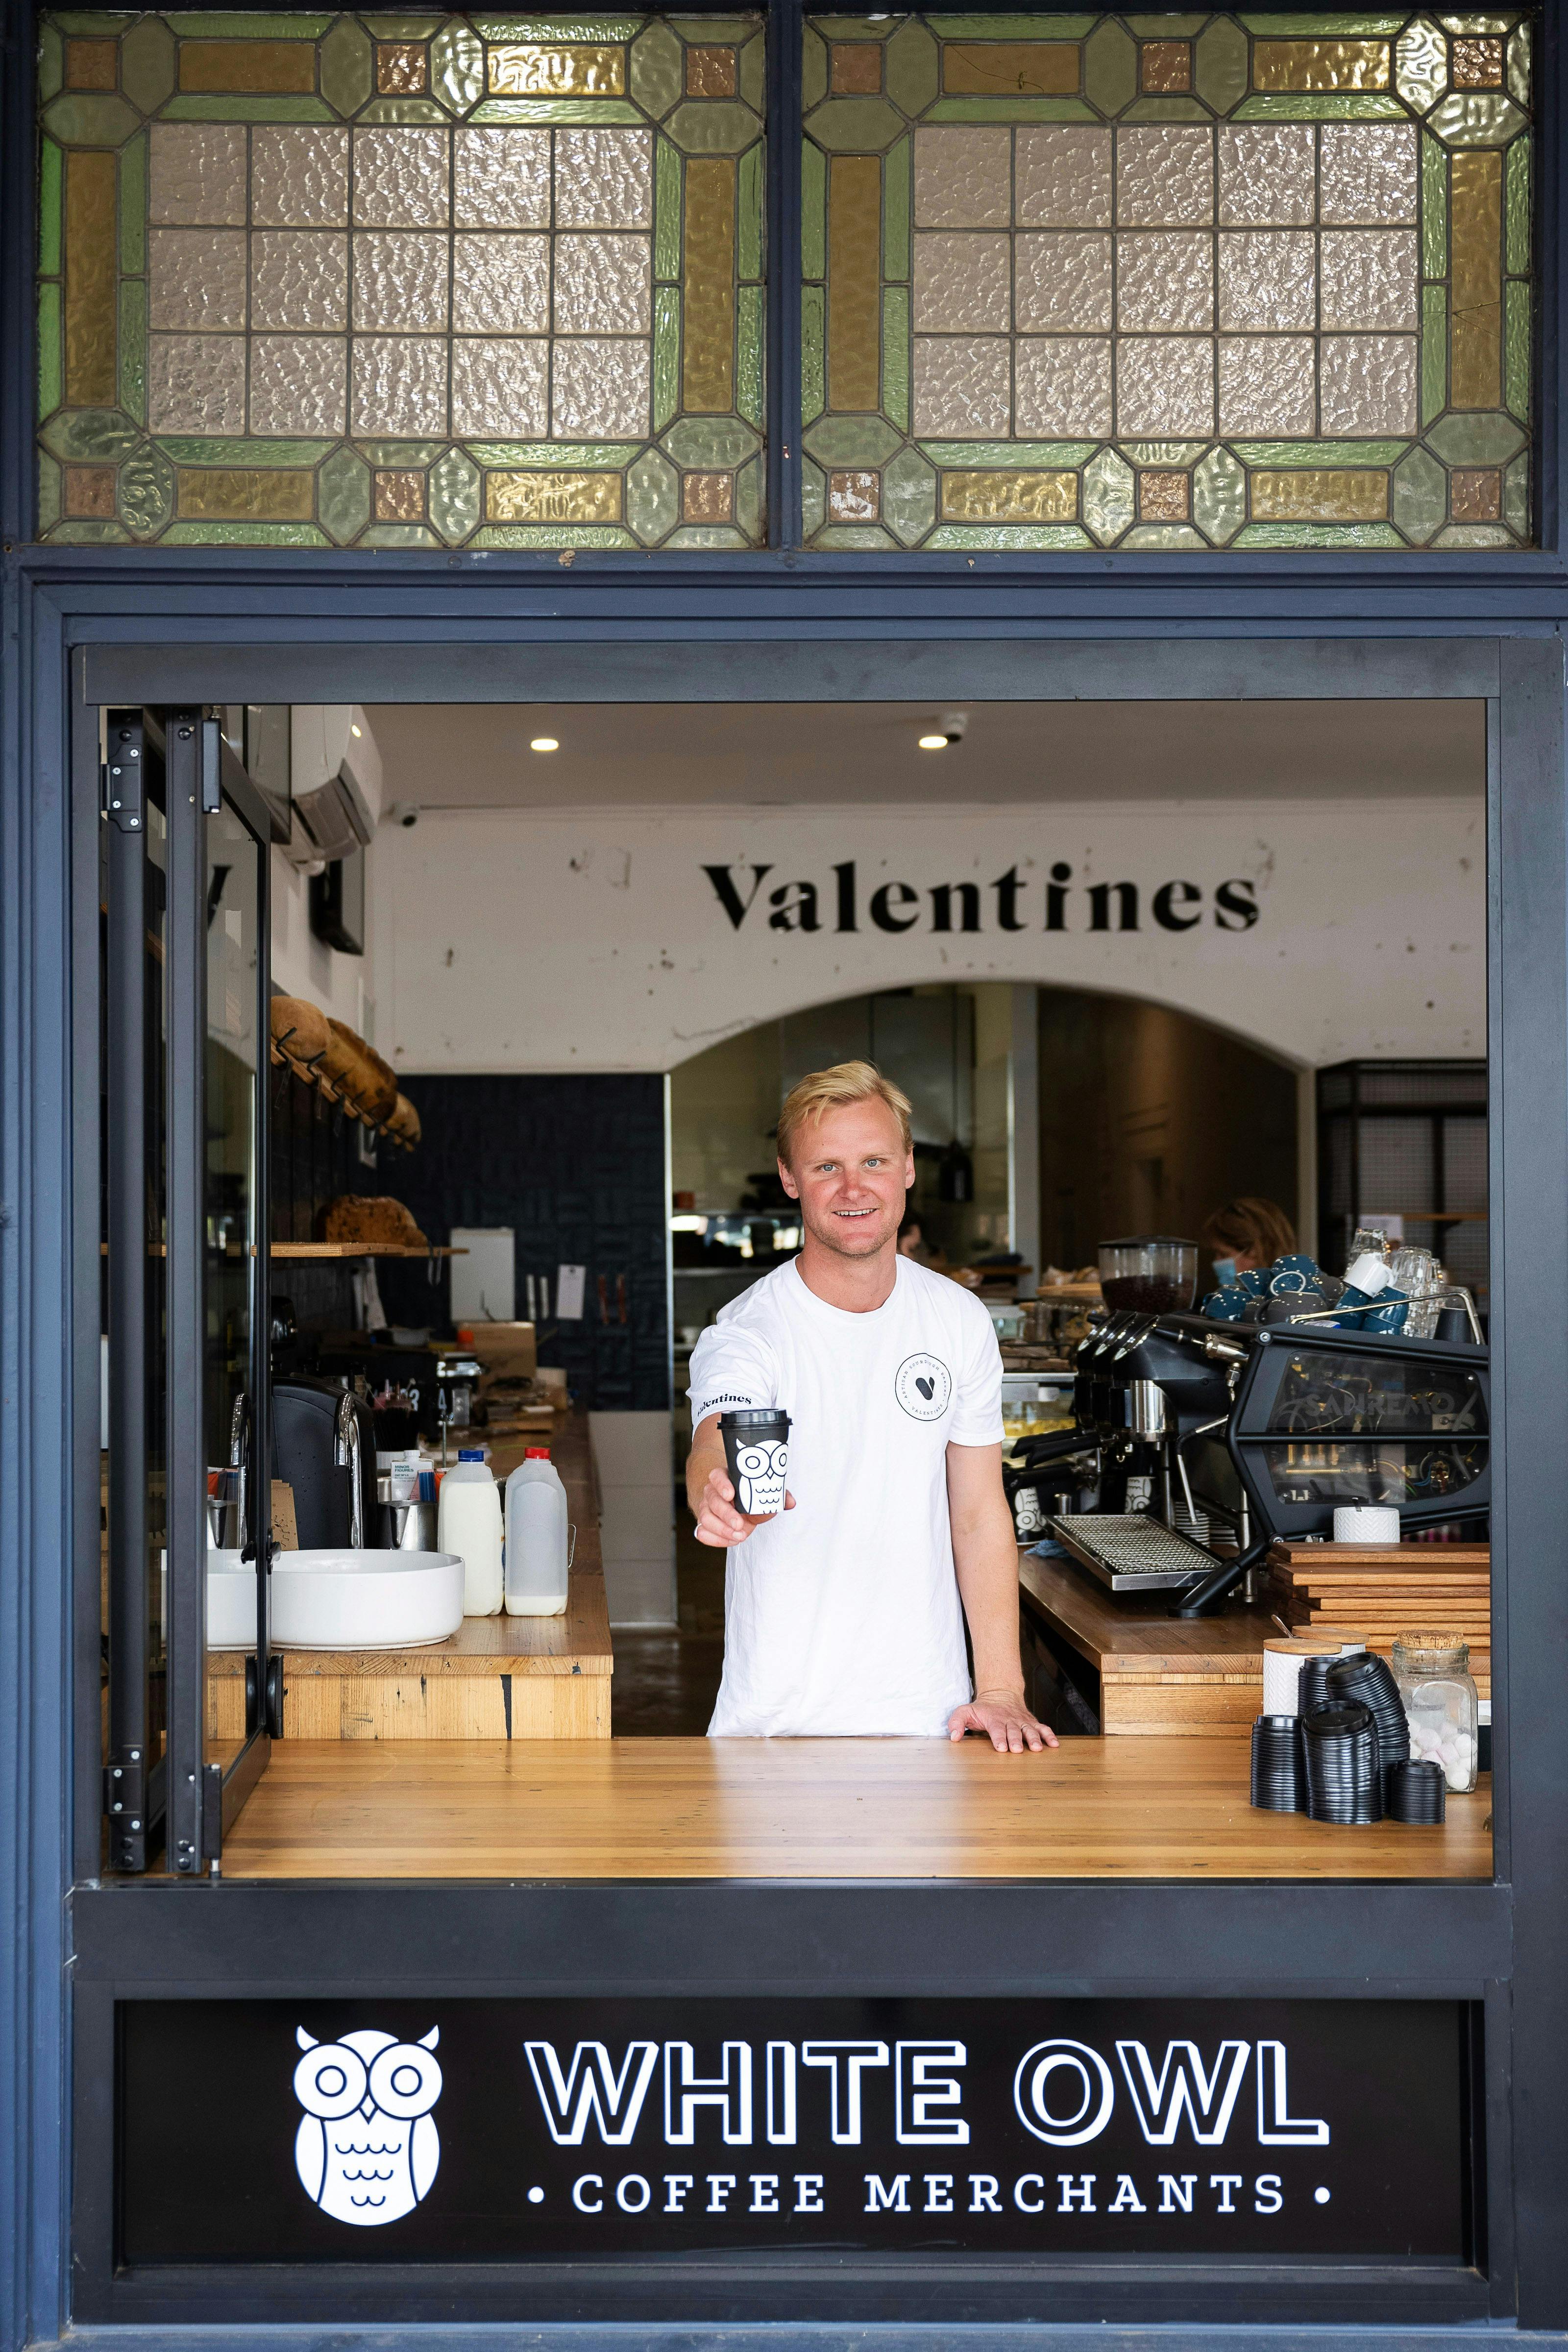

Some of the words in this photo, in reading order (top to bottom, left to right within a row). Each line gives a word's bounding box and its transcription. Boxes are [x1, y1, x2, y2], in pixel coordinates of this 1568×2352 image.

[700, 860, 1260, 934] Valentines
[697, 1394, 752, 1417] alentines
[912, 1403, 943, 1415] VALENTINES
[1304, 1392, 1455, 1416] SANREMO
[523, 2040, 970, 2146] WHITE
[1013, 2038, 1330, 2147] OWL
[572, 2174, 824, 2213] COFFEE
[863, 2174, 1283, 2213] MERCHANTS
